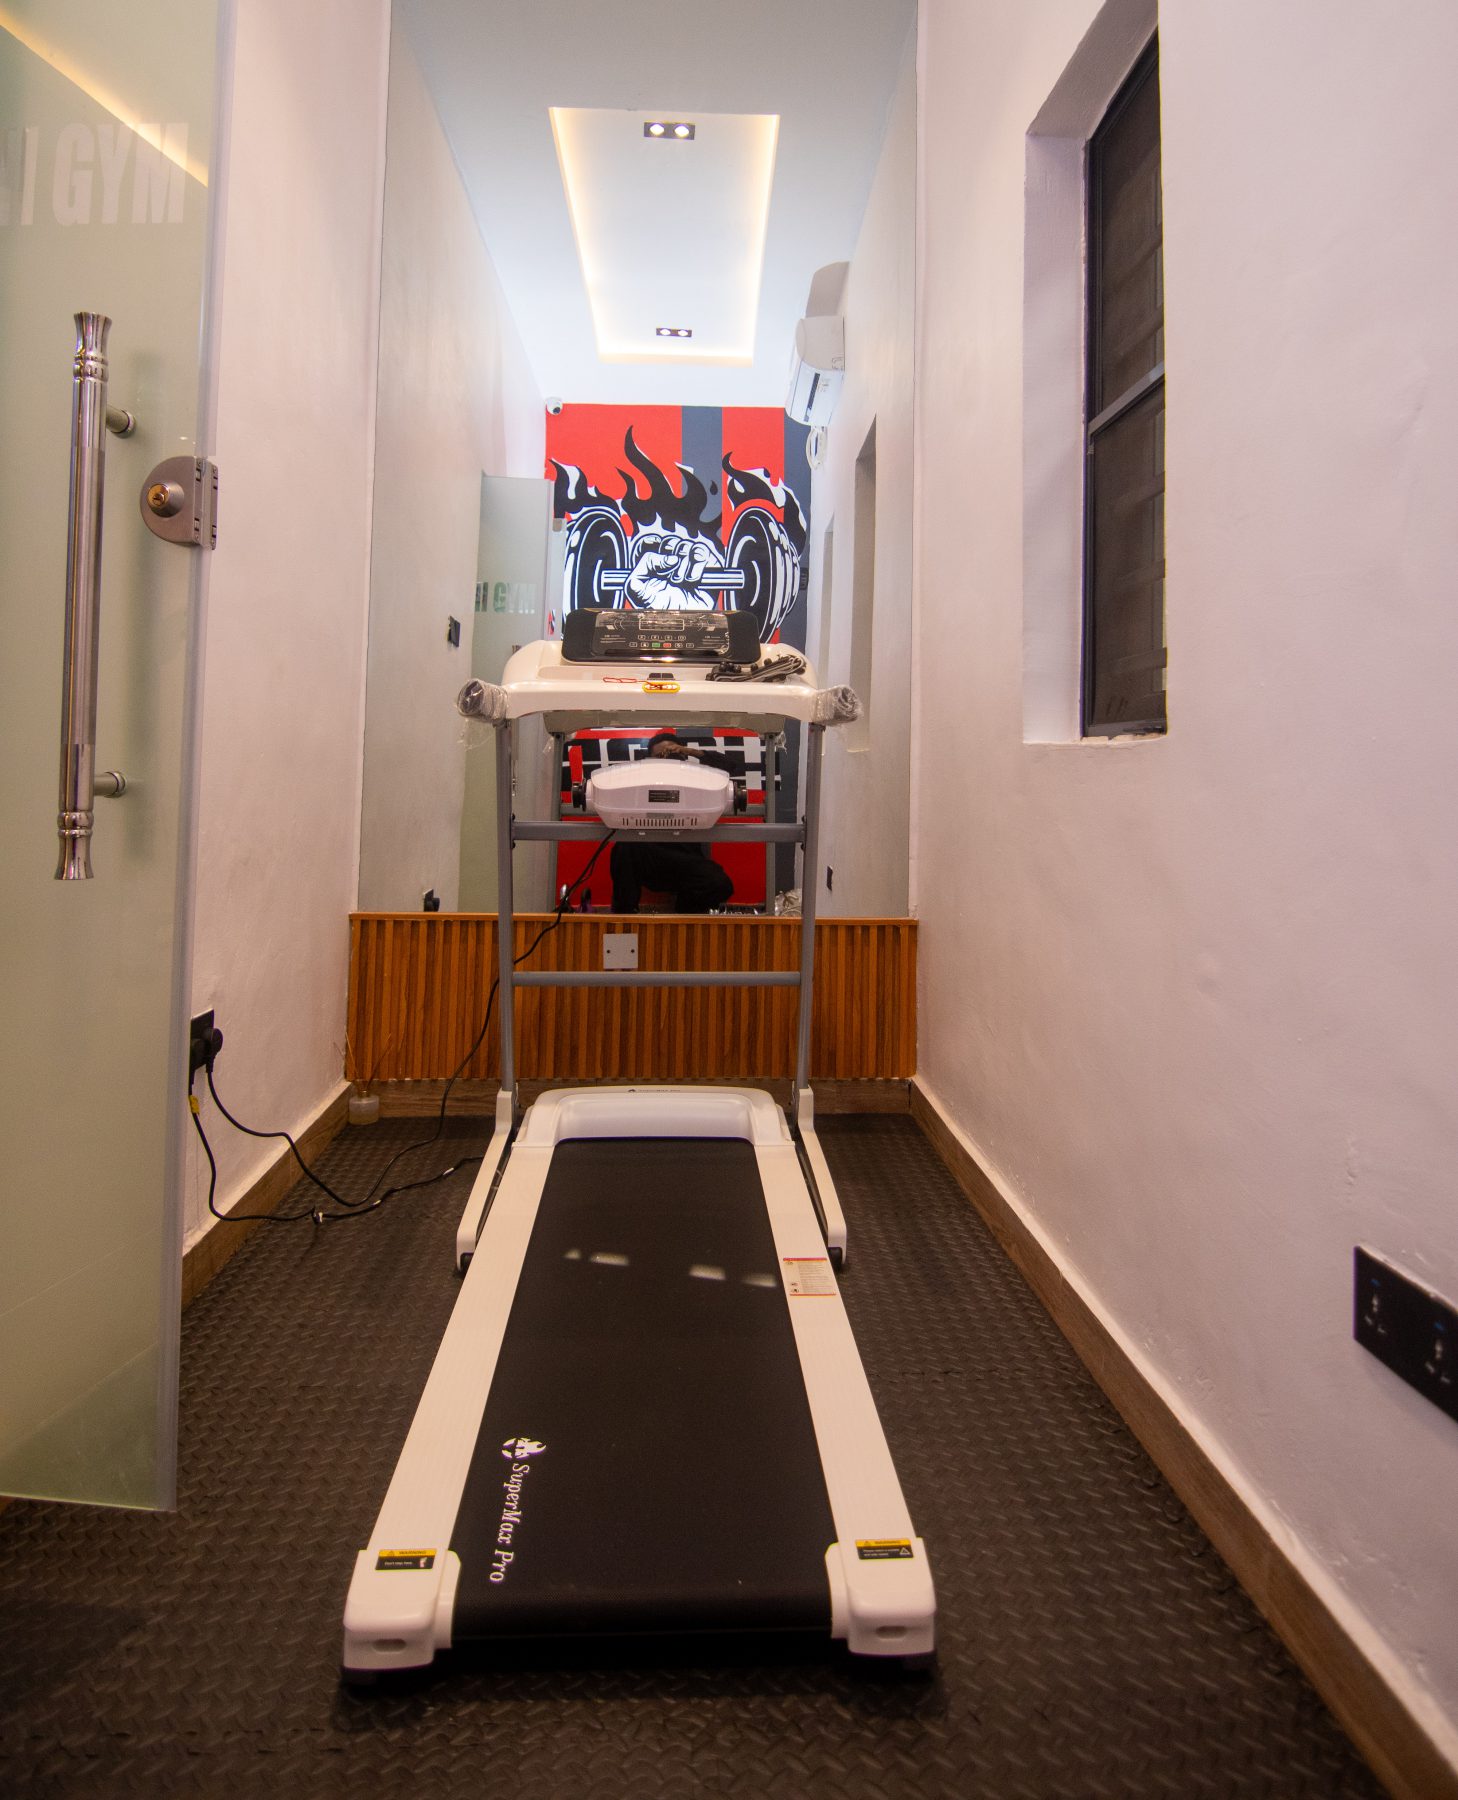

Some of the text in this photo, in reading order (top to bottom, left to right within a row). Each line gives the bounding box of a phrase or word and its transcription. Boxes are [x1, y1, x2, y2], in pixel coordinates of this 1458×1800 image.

[53, 122, 189, 226] GYM
[489, 1463, 530, 1583] SuperMax Pro
